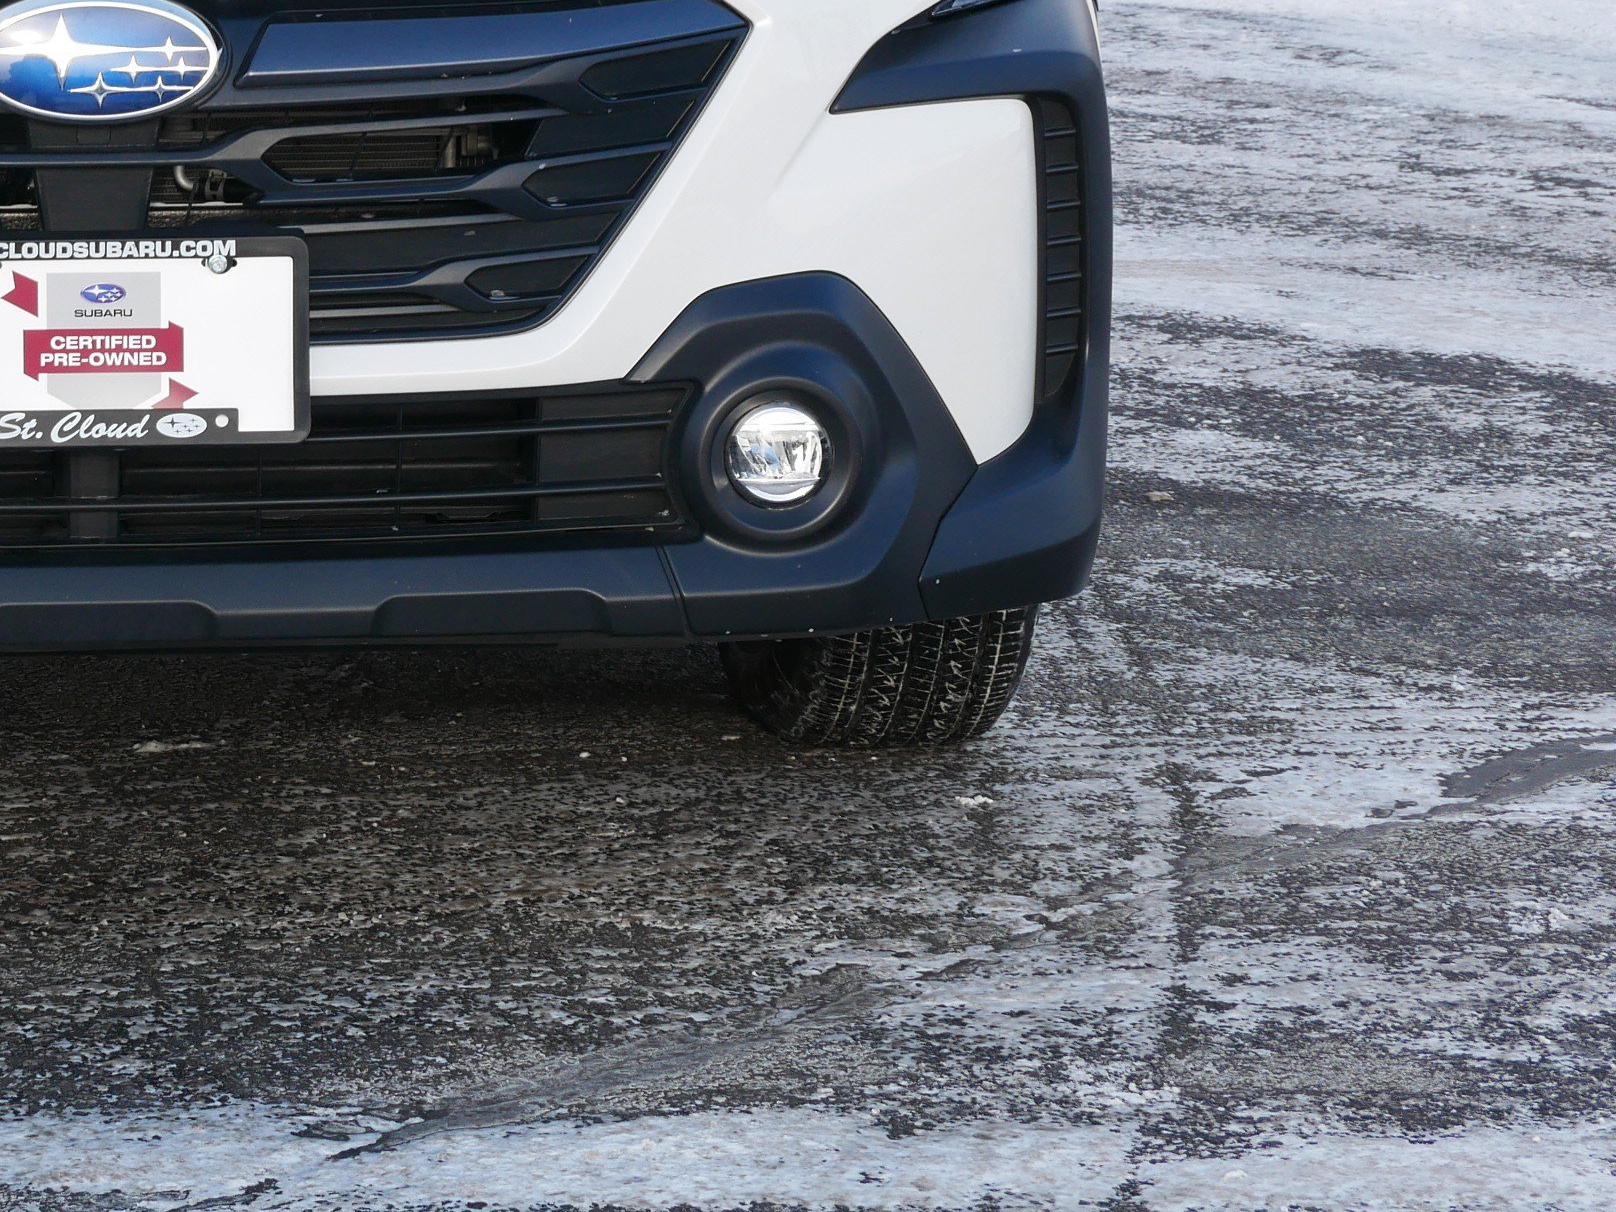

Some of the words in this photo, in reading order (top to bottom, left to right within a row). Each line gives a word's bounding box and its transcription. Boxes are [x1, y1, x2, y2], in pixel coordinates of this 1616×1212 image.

[74, 308, 133, 318] SUBARU
[49, 335, 157, 351] CERTIFIED
[40, 351, 167, 367] PRE-OWNED
[50, 412, 150, 443] Cloud
